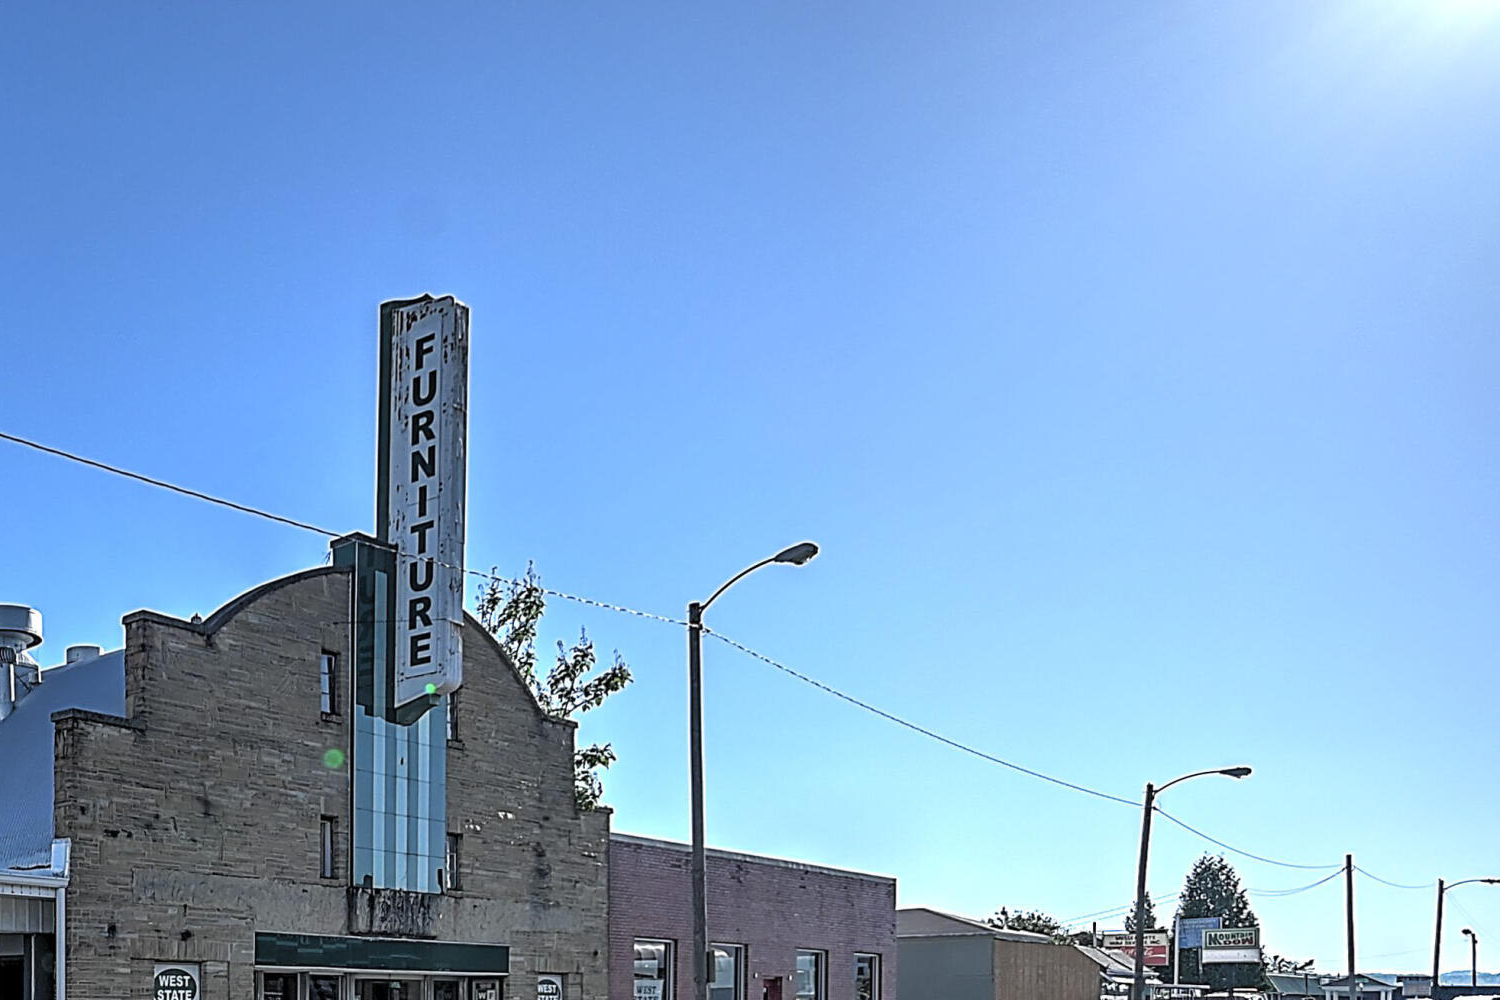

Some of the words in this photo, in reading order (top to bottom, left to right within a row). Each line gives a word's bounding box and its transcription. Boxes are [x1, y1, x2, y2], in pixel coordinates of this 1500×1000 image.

[408, 332, 437, 668] FURNITURE
[159, 975, 190, 987] WEST
[538, 984, 557, 994] WEST
[637, 985, 657, 995] WEST
